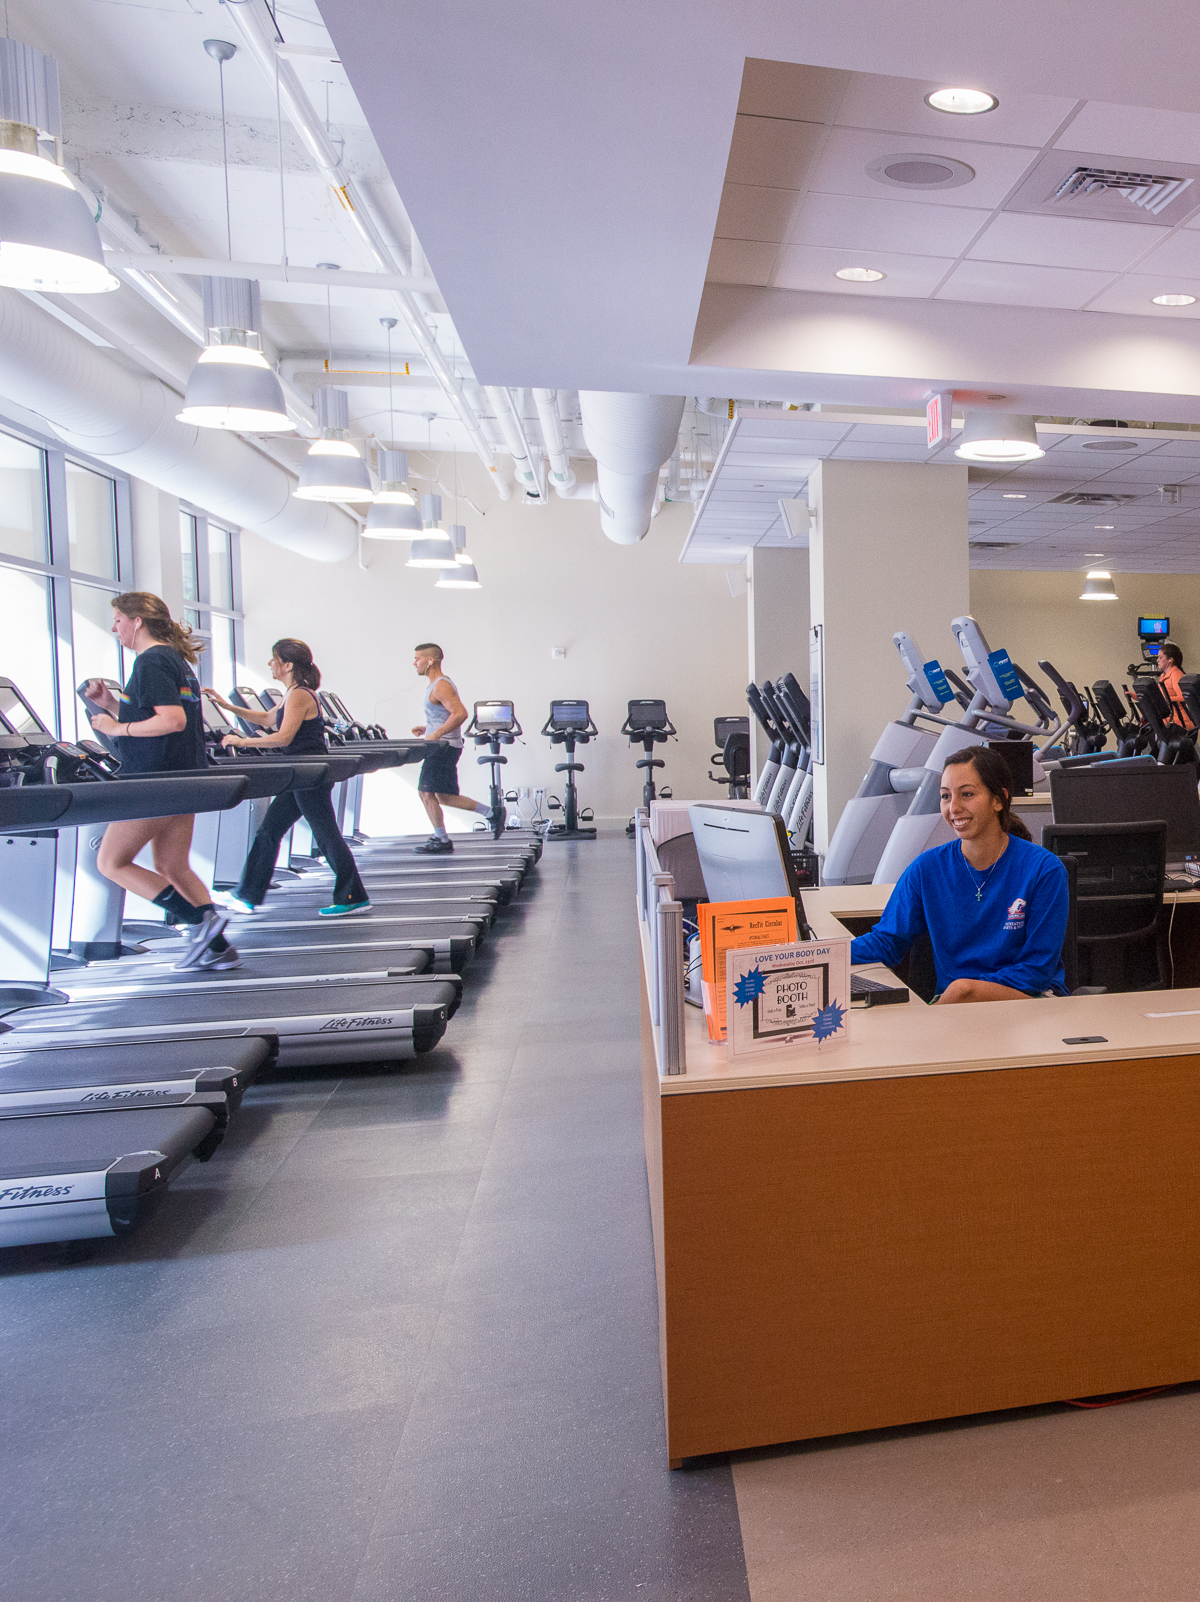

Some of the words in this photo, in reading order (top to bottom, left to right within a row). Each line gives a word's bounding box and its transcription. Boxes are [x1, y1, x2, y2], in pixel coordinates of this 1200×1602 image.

[754, 954, 774, 963] LOVE
[774, 951, 795, 961] YOUR
[795, 949, 815, 959] BODY
[816, 947, 831, 956] DAY
[776, 981, 808, 994] PHOTO
[776, 992, 808, 1005] BOOTH
[440, 1011, 445, 1020] C
[232, 1077, 238, 1087] B
[154, 1167, 161, 1180] A
